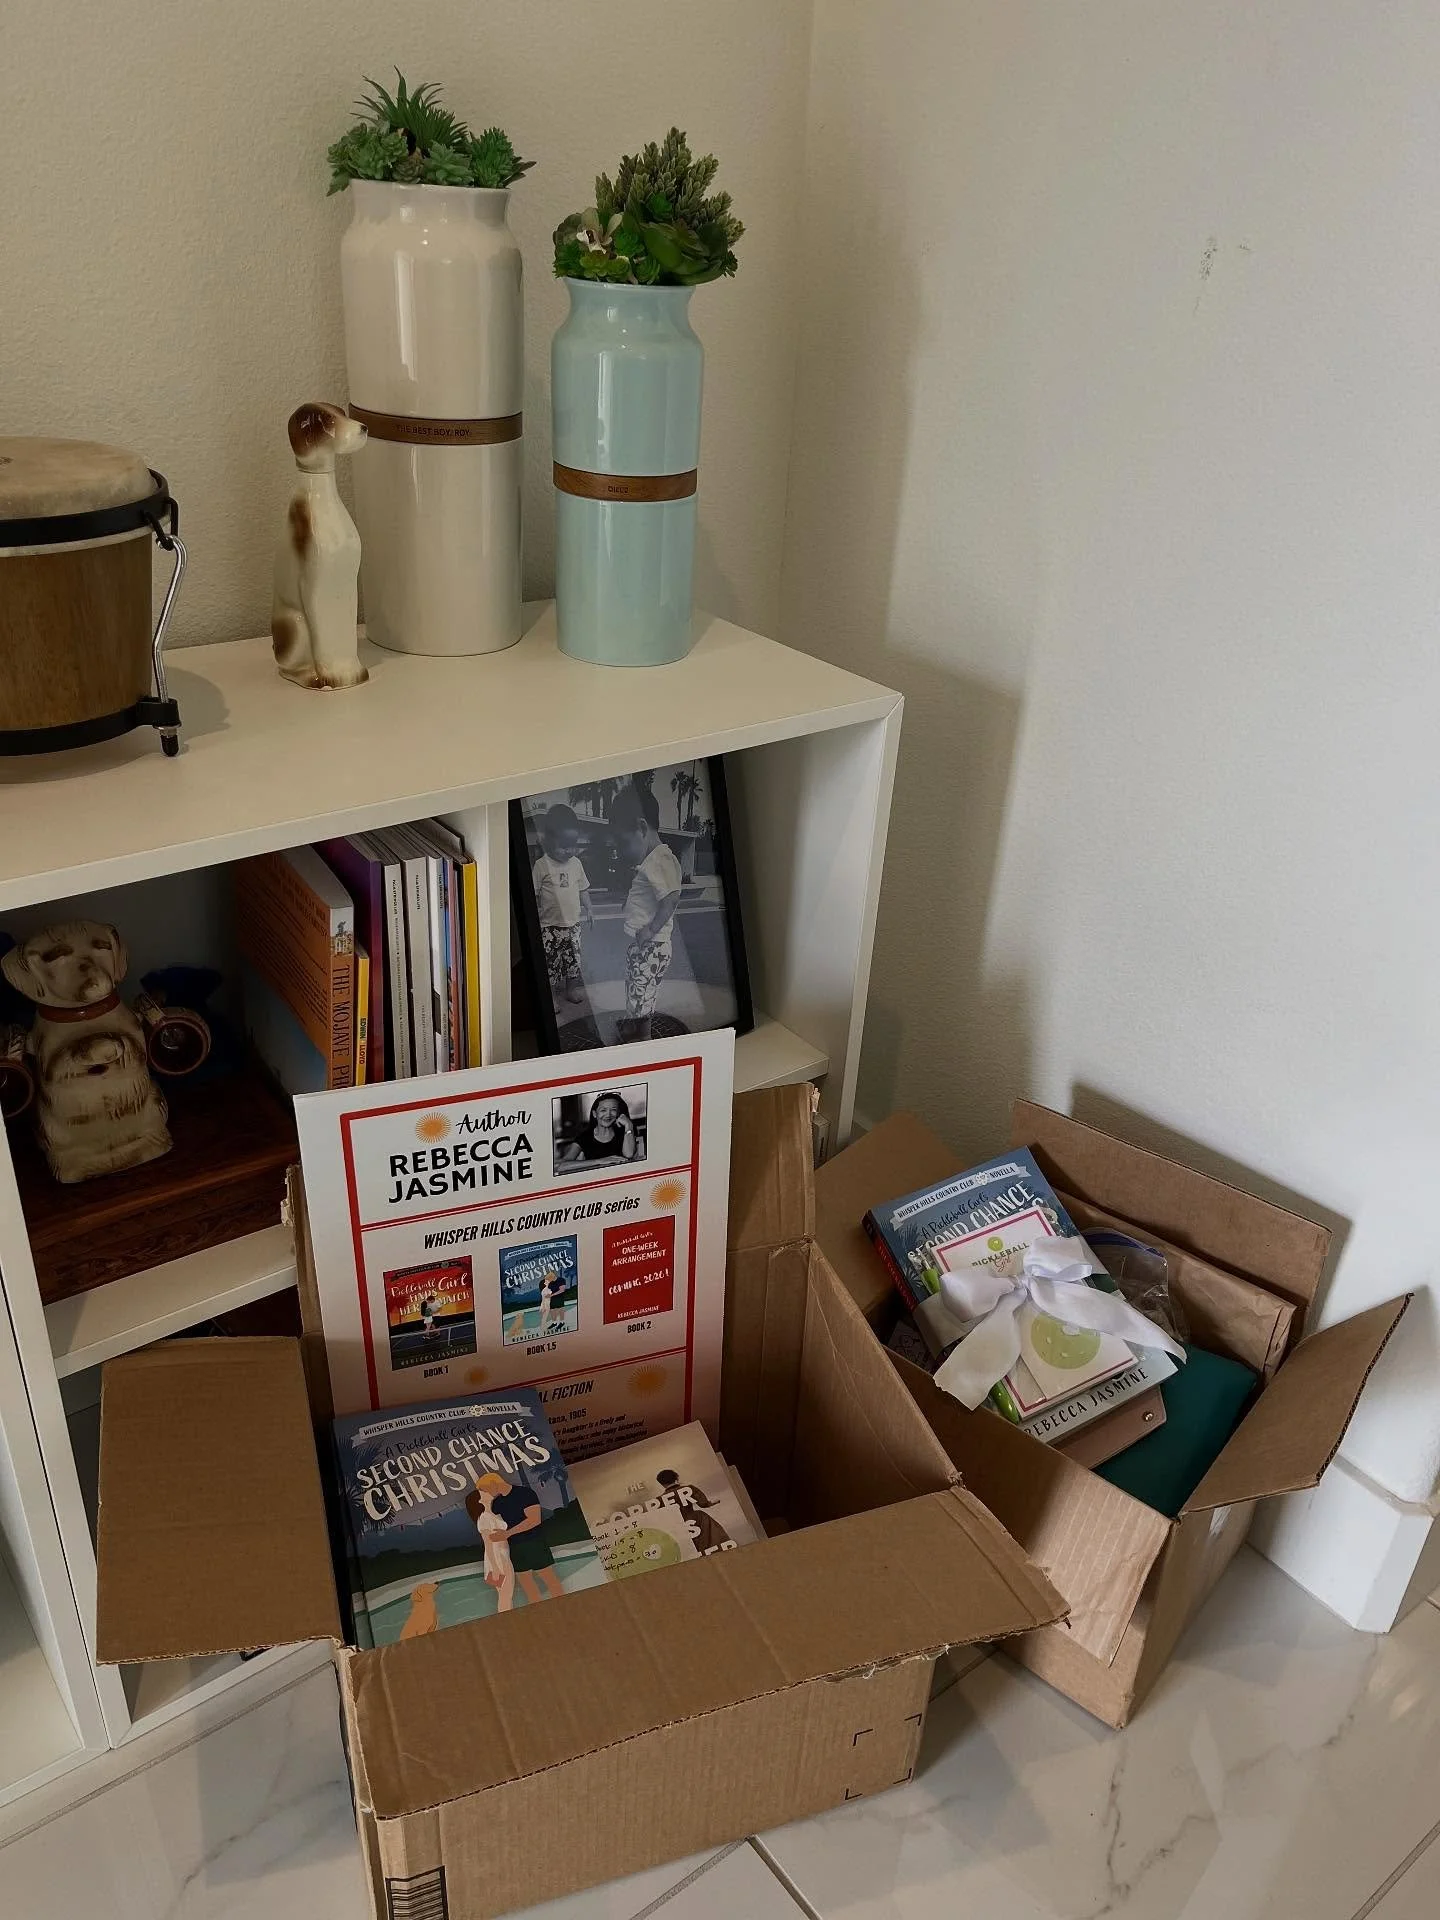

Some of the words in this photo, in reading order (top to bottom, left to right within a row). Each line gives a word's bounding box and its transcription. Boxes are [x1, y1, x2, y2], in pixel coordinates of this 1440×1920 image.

[412, 426, 431, 436] BEST
[454, 428, 471, 437] ROY
[332, 964, 350, 996] THE
[332, 1001, 350, 1058] MOJAVE
[456, 1110, 532, 1134] Author
[390, 1133, 534, 1178] REBECCA
[388, 1157, 532, 1203] JASMINE
[898, 1203, 920, 1218] WHISPER
[920, 1196, 936, 1206] HILLS
[936, 1186, 960, 1200] COUNTRY
[960, 1180, 974, 1190] CLUB
[990, 1166, 1016, 1178] NOVELLA
[970, 1180, 1035, 1228] CHANCE
[424, 1225, 478, 1250] WHISPER
[480, 1218, 514, 1239] HILLS
[516, 1207, 572, 1232] COUNTRY
[572, 1200, 602, 1220] CLUB
[604, 1196, 642, 1214] series
[920, 1226, 928, 1239] A
[928, 1204, 968, 1234] Pickleball
[504, 1260, 536, 1277] SECOND
[538, 1250, 568, 1266] CHANCE
[612, 1249, 666, 1266] ARRANGEMENT
[622, 1241, 659, 1255] ONE-WEEK
[438, 1272, 468, 1291] Girl
[506, 1256, 574, 1288] CHRISTMAS
[628, 1322, 645, 1334] BOOK
[646, 1320, 652, 1329] 2
[526, 1345, 545, 1356] BOOK
[546, 1342, 557, 1350] 1.5
[424, 1366, 444, 1378] BOOK
[444, 1365, 448, 1374] 1
[1089, 1367, 1148, 1406] JASMINE
[552, 1380, 594, 1401] FICTION
[363, 1423, 394, 1436] WHISPER
[395, 1417, 415, 1428] HILLS
[416, 1412, 448, 1423] COUNTRY
[448, 1409, 466, 1418] CLUB
[487, 1404, 518, 1412] NOVELLA
[548, 1414, 568, 1424] tana,
[570, 1408, 587, 1420] 1905
[356, 1446, 442, 1488] SECOND
[448, 1418, 531, 1458] CHANCE
[383, 1446, 394, 1458] A
[396, 1430, 449, 1453] Pickleball
[363, 1436, 551, 1521] CHRISTMAS
[626, 1482, 646, 1496] THE
[596, 1486, 698, 1527] OPPER
